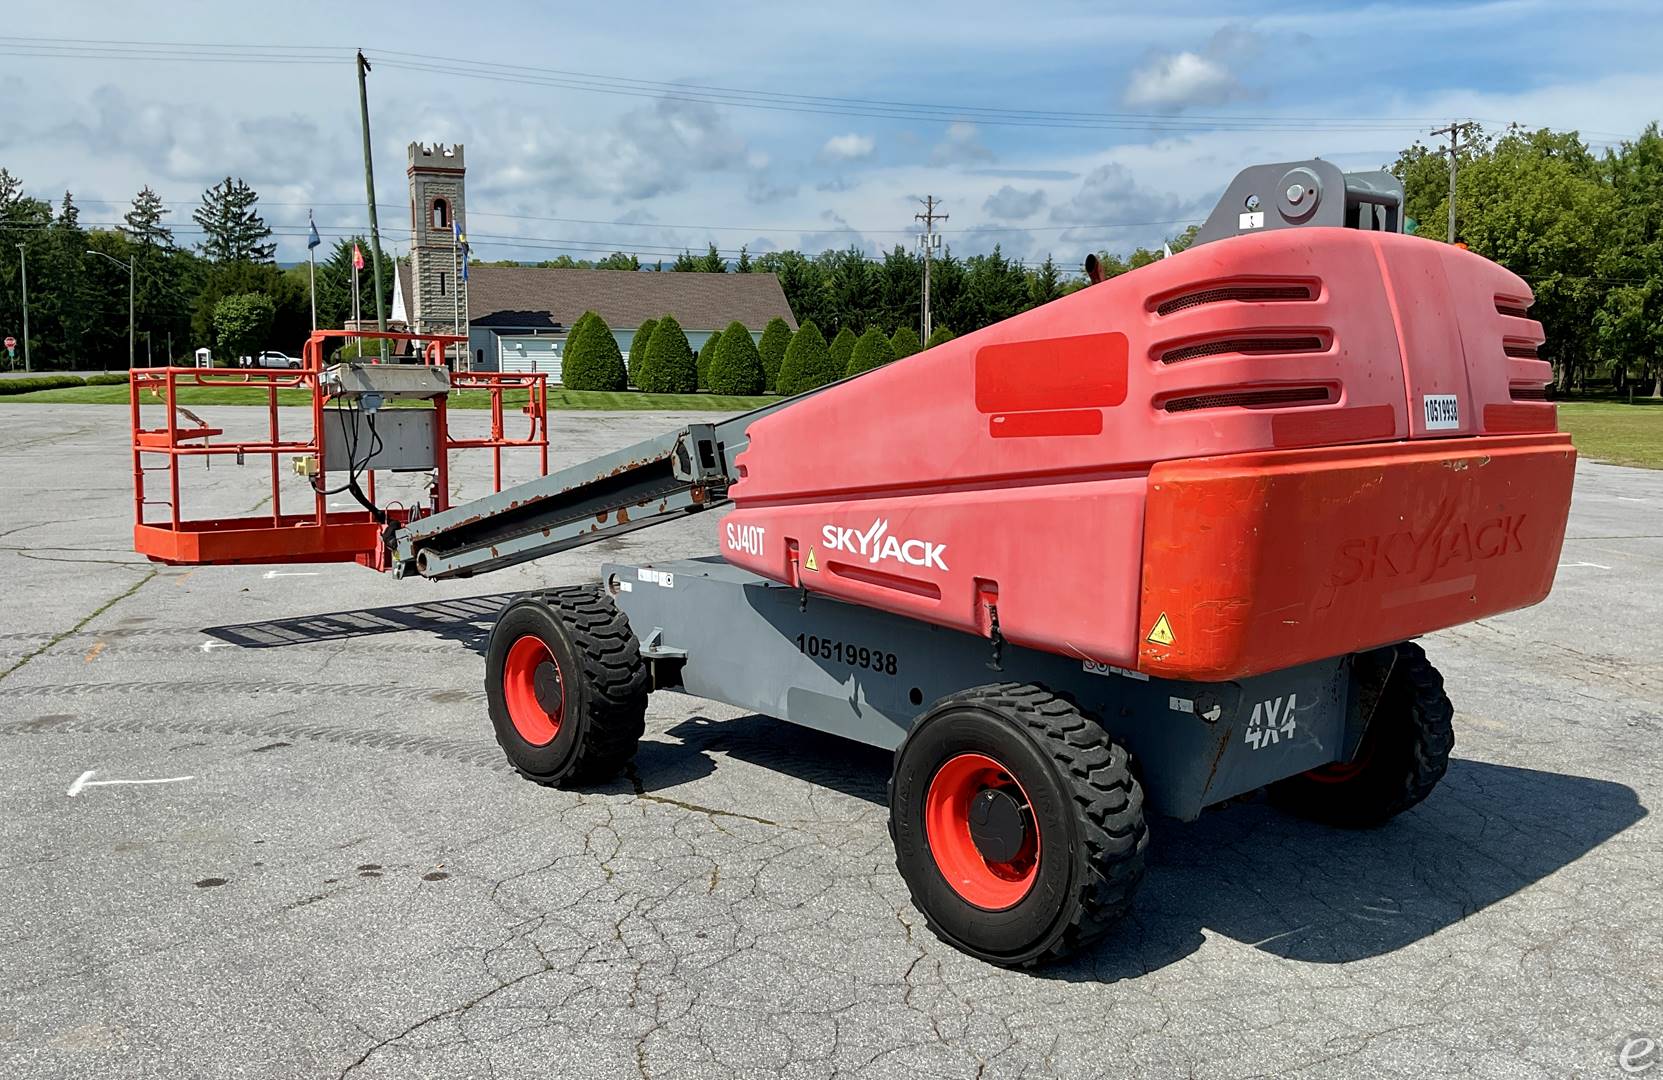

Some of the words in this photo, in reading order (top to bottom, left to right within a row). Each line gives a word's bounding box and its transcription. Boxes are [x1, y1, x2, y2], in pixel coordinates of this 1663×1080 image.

[1425, 399, 1457, 421] 10519938
[727, 523, 765, 556] SJ40T
[822, 517, 949, 571] SKYJACK
[1331, 498, 1527, 587] SKYJACK
[796, 633, 898, 675] 10519938
